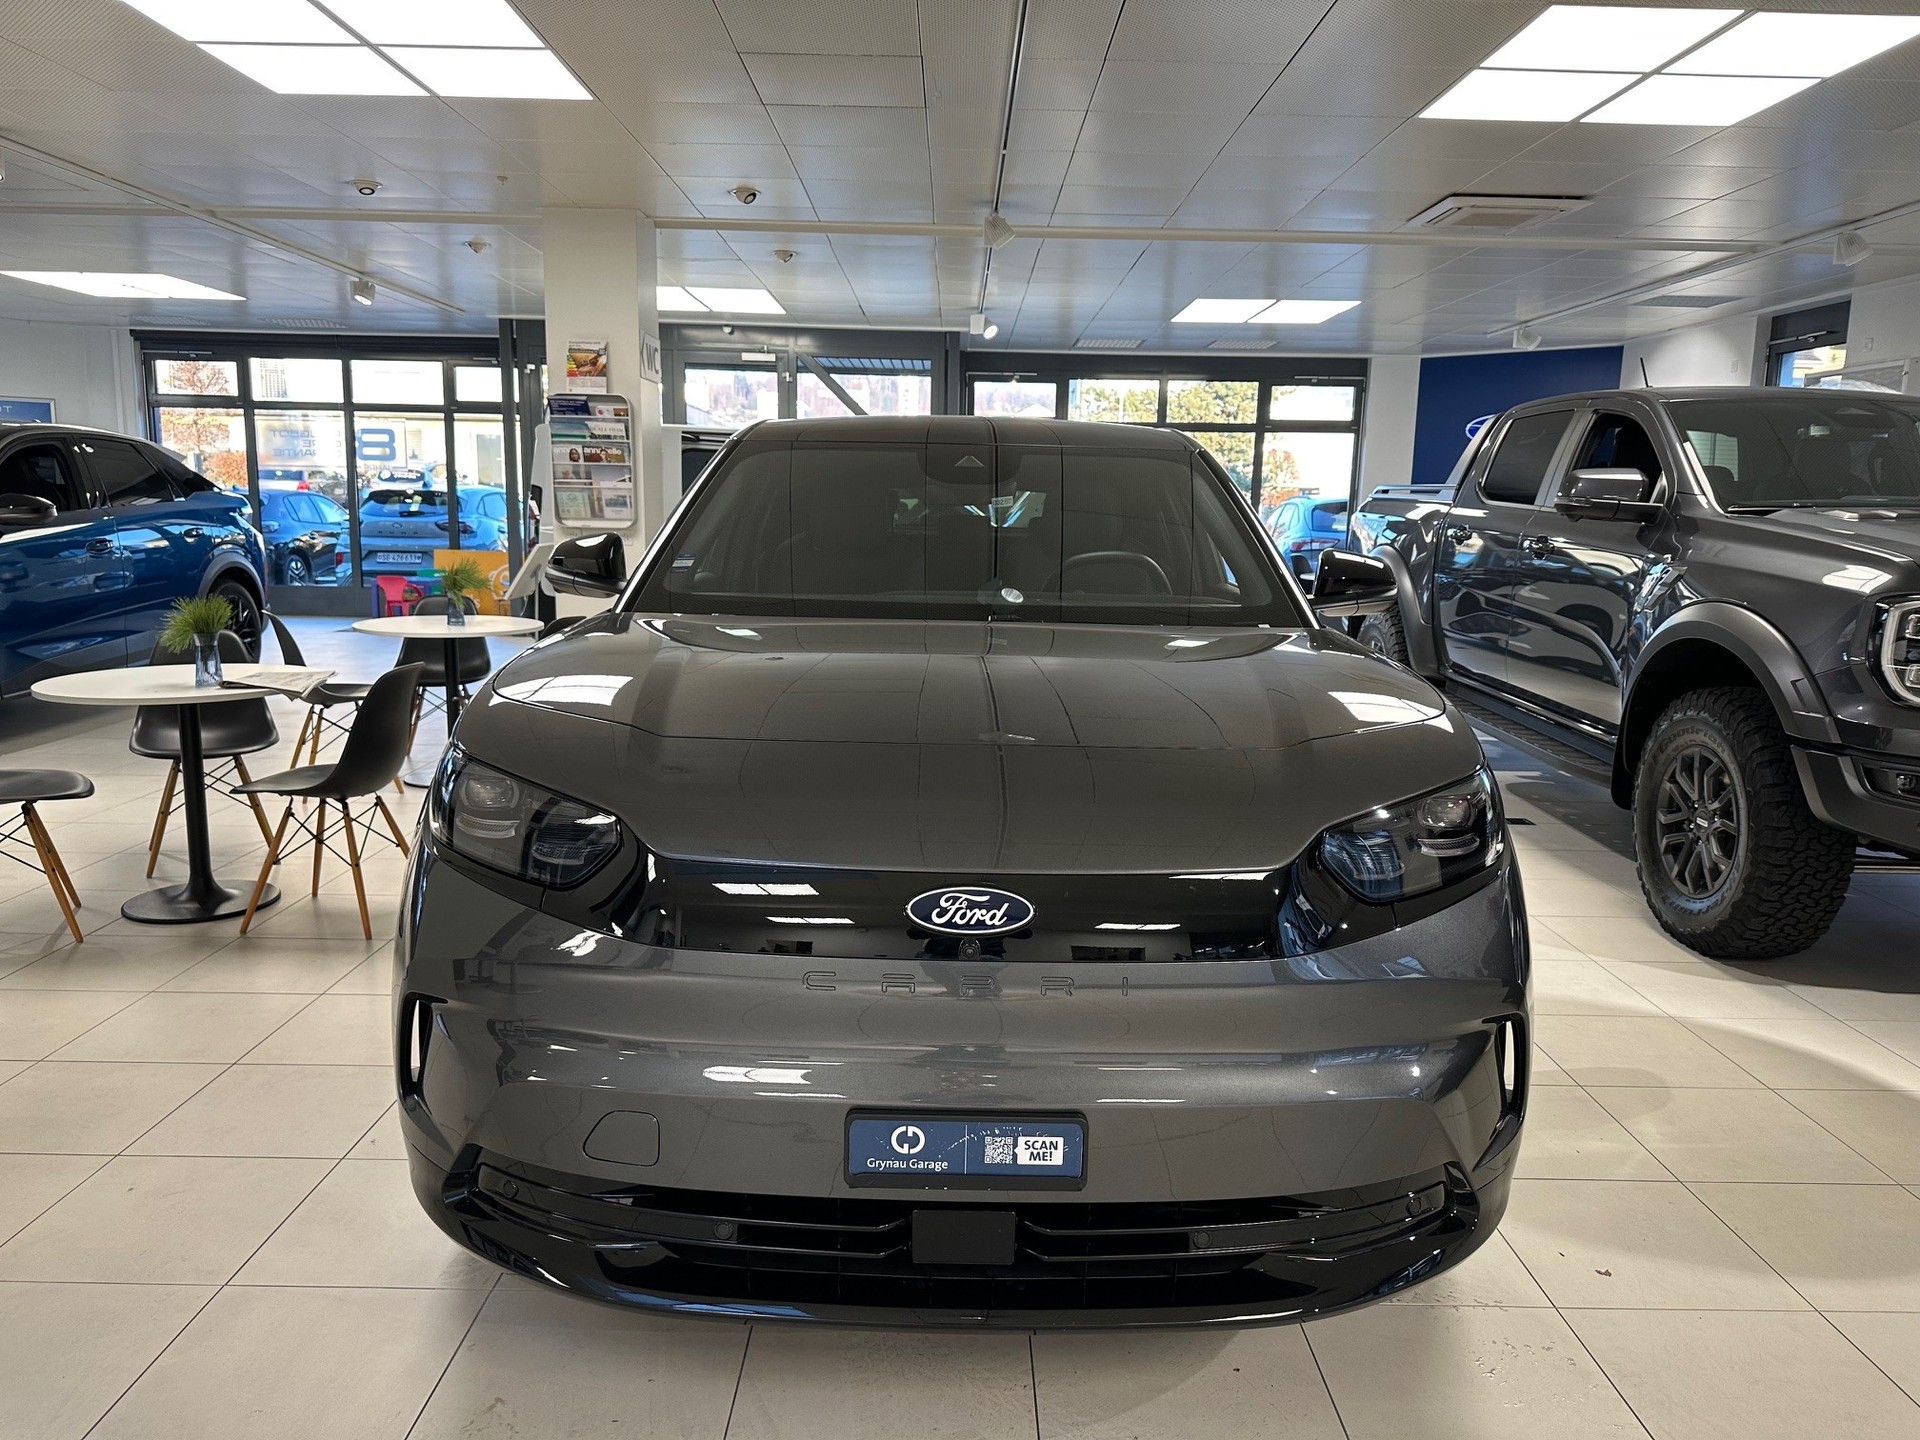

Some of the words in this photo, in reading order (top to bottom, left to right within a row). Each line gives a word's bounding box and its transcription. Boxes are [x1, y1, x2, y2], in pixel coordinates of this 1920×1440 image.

[645, 342, 659, 375] WC
[931, 892, 1010, 926] Ford
[802, 970, 1129, 997] CAPRI
[1024, 1139, 1059, 1151] SCAN
[866, 1157, 907, 1173] Grynau
[908, 1158, 949, 1173] Garage
[1028, 1150, 1053, 1162] ME!
